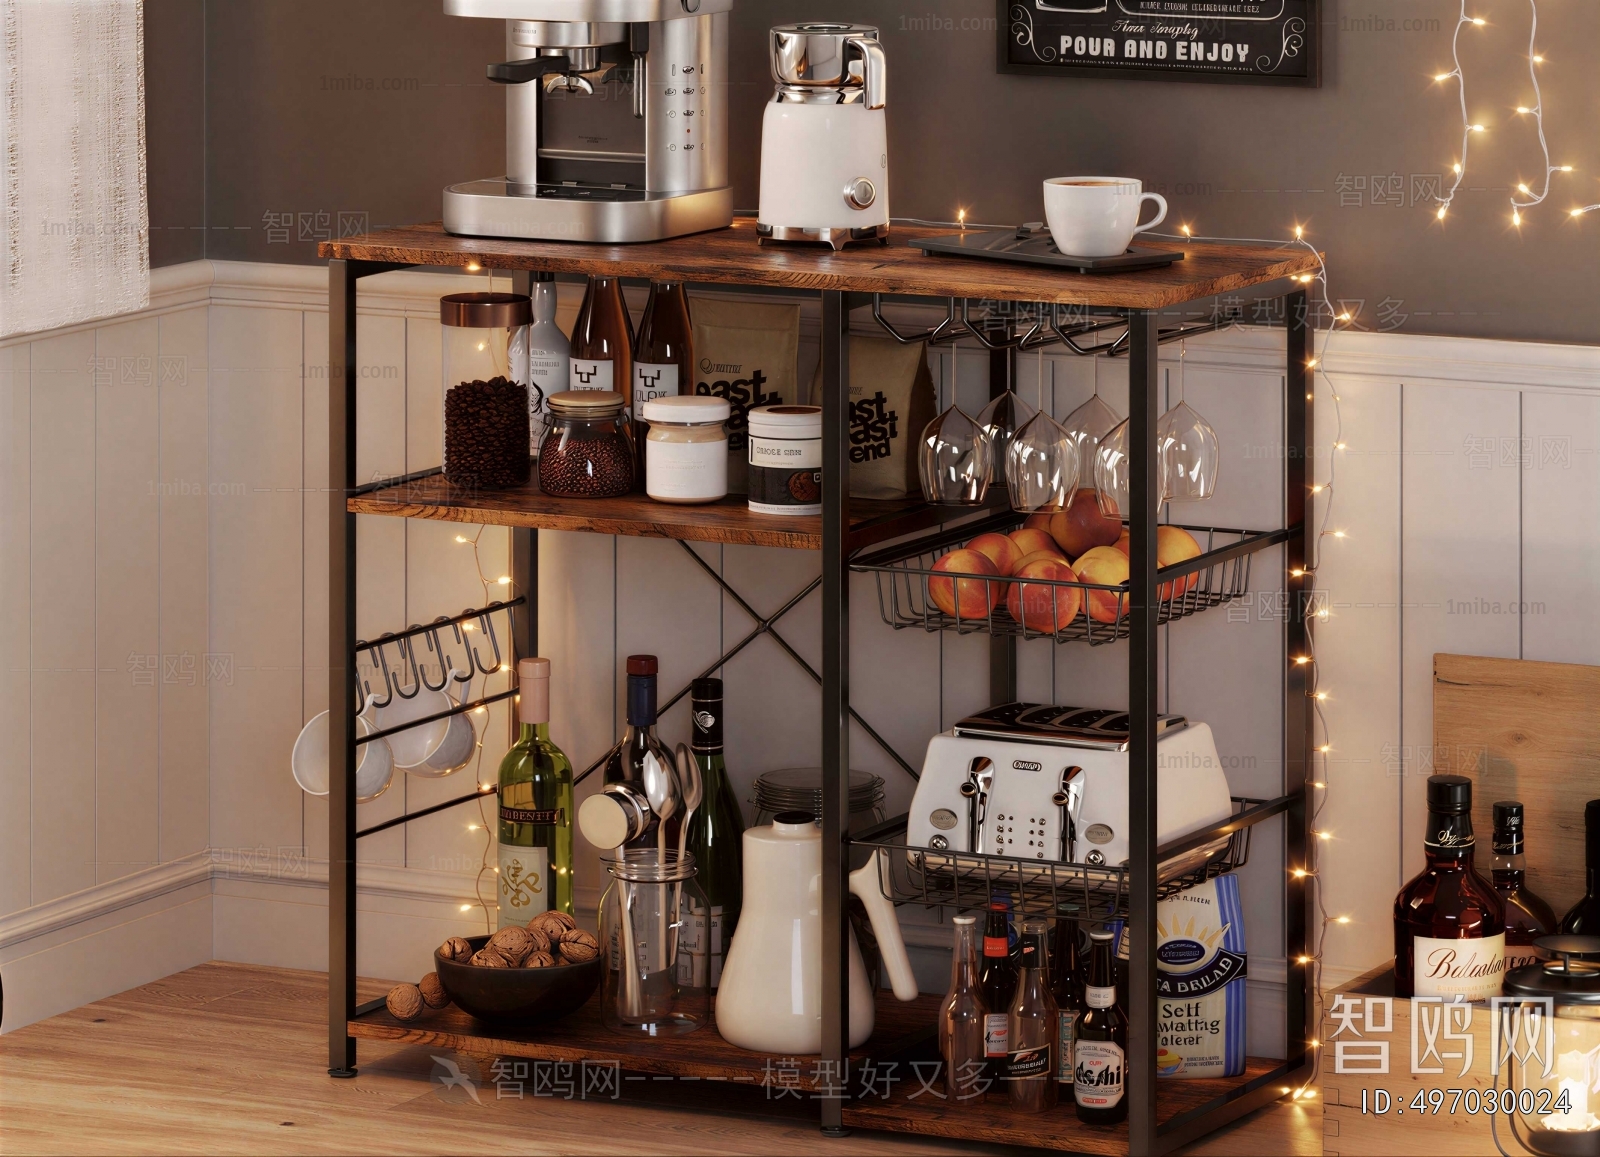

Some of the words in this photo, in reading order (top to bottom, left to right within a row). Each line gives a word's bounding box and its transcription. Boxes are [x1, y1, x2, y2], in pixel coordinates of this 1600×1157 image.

[1060, 35, 1115, 57] POUR
[1124, 39, 1167, 60] AND
[1176, 41, 1249, 63] ENJOY
